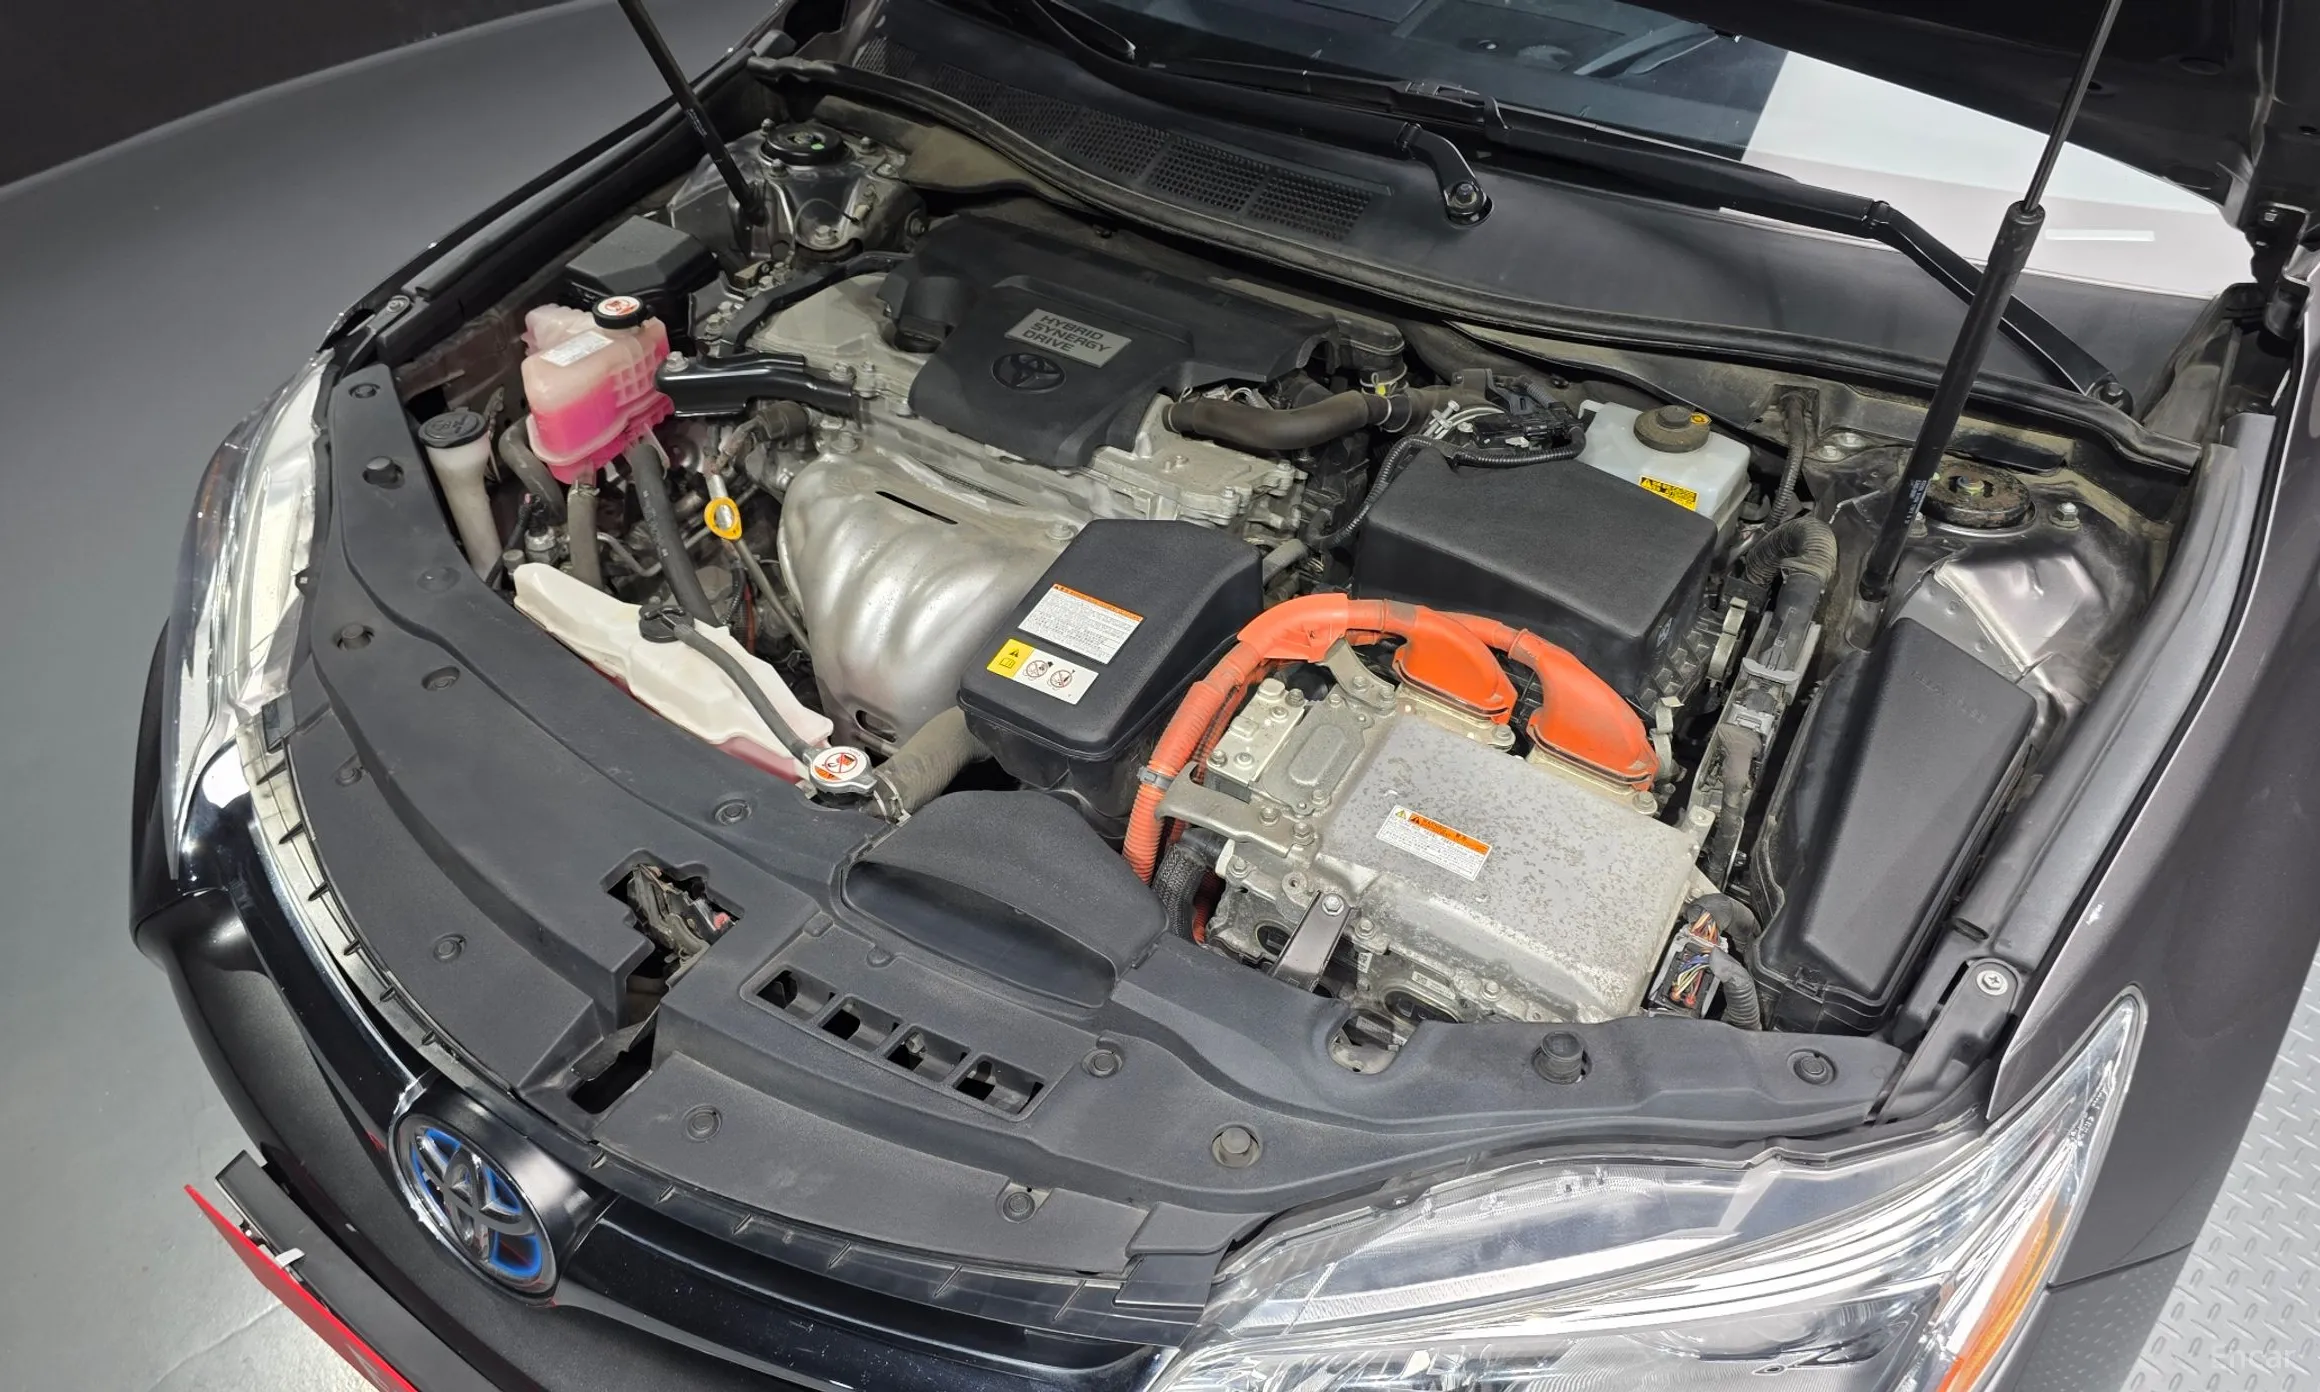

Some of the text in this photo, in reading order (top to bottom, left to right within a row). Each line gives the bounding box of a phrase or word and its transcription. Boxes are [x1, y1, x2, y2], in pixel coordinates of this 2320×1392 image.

[1031, 322, 1112, 352] SYNERGY
[1040, 315, 1104, 340] HYBRID
[1022, 329, 1075, 352] DRIVE
